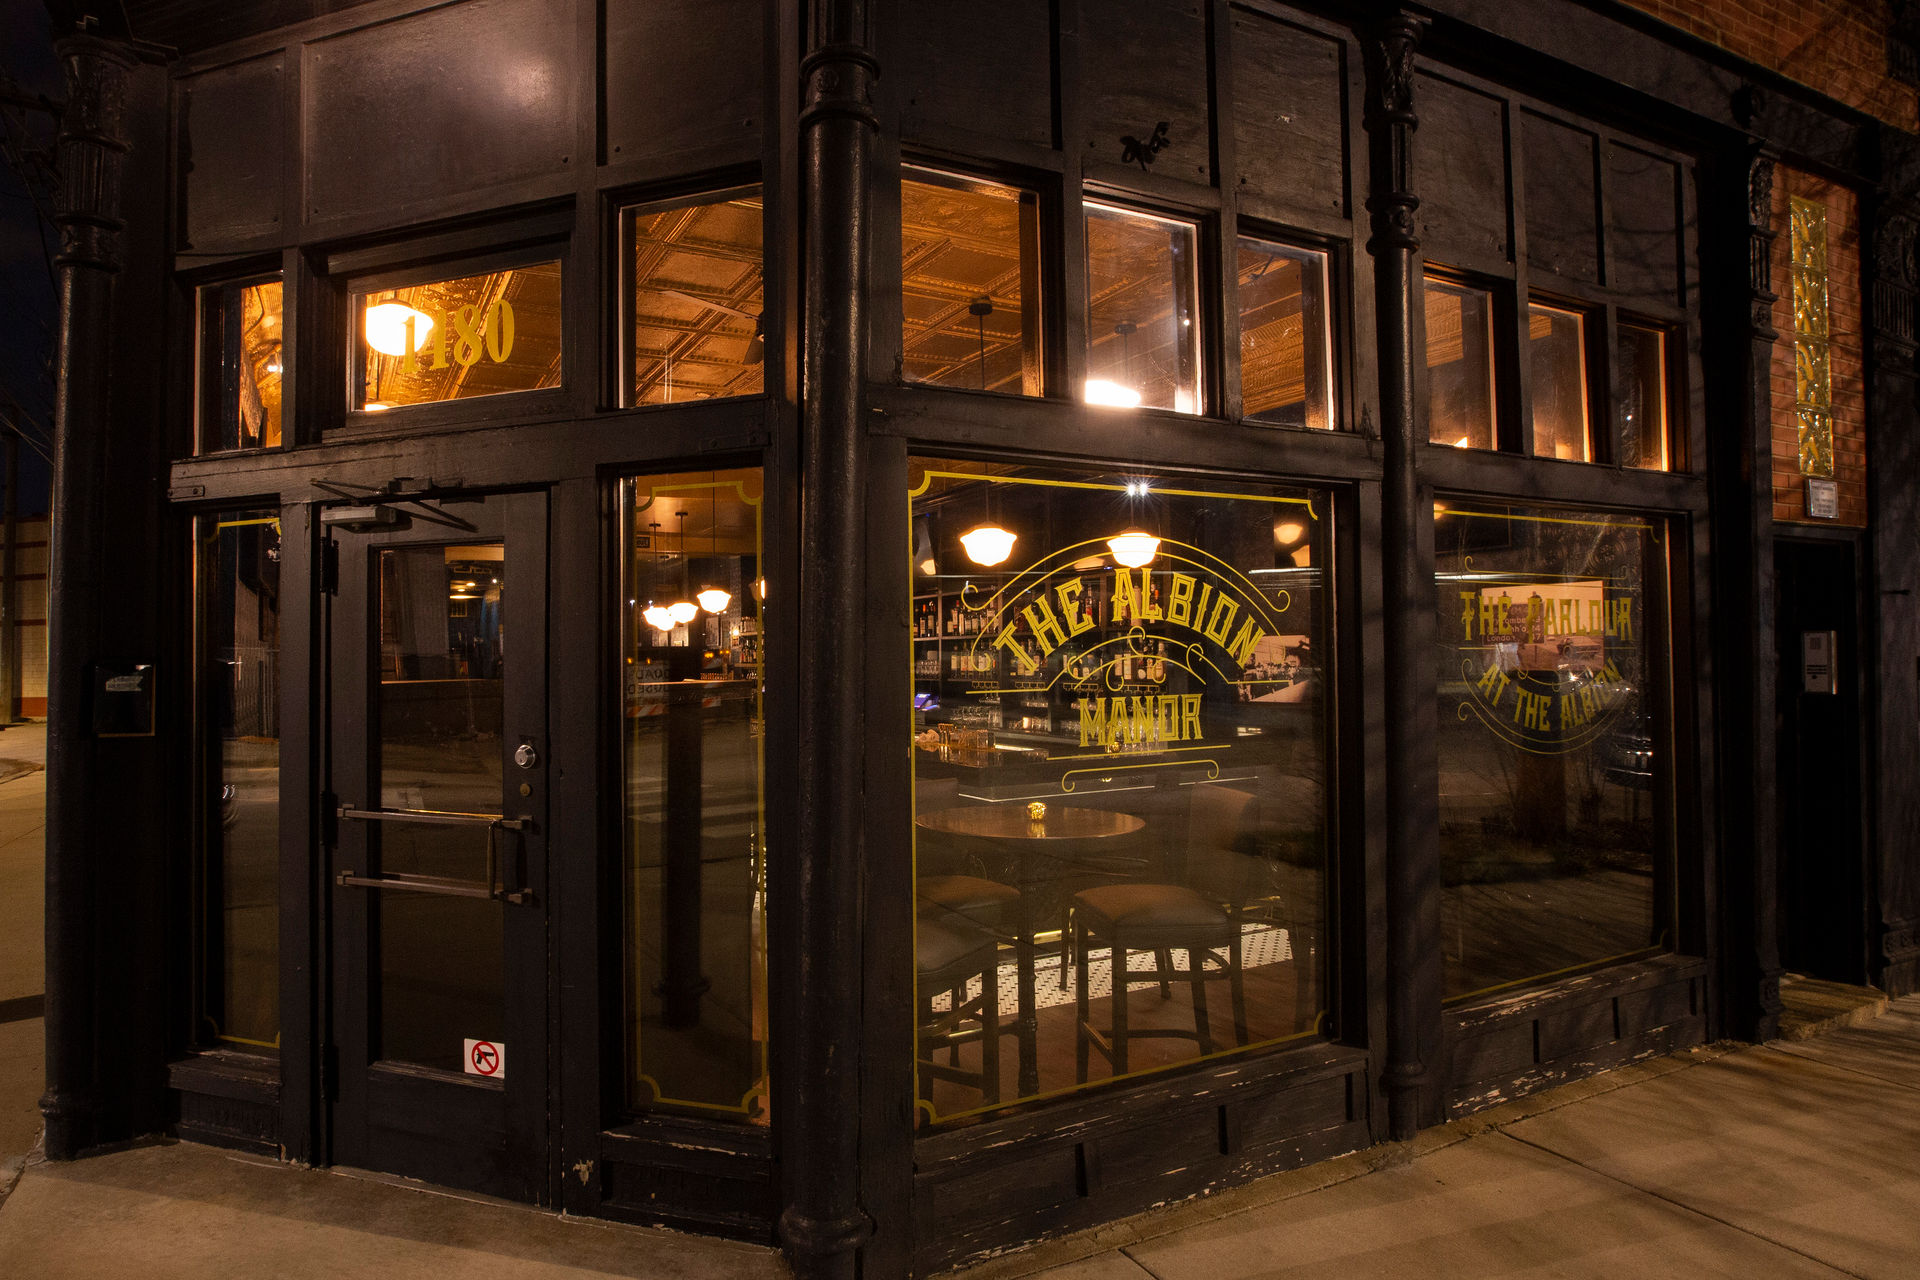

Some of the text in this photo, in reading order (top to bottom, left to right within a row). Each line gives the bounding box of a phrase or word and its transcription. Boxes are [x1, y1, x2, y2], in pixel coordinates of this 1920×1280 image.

[401, 299, 514, 374] 1480
[992, 567, 1266, 673] THE ALBION
[1460, 591, 1632, 644] THE PARLOUR
[1079, 693, 1204, 747] MANOR
[1477, 663, 1511, 707] AT
[1513, 686, 1552, 732] THE
